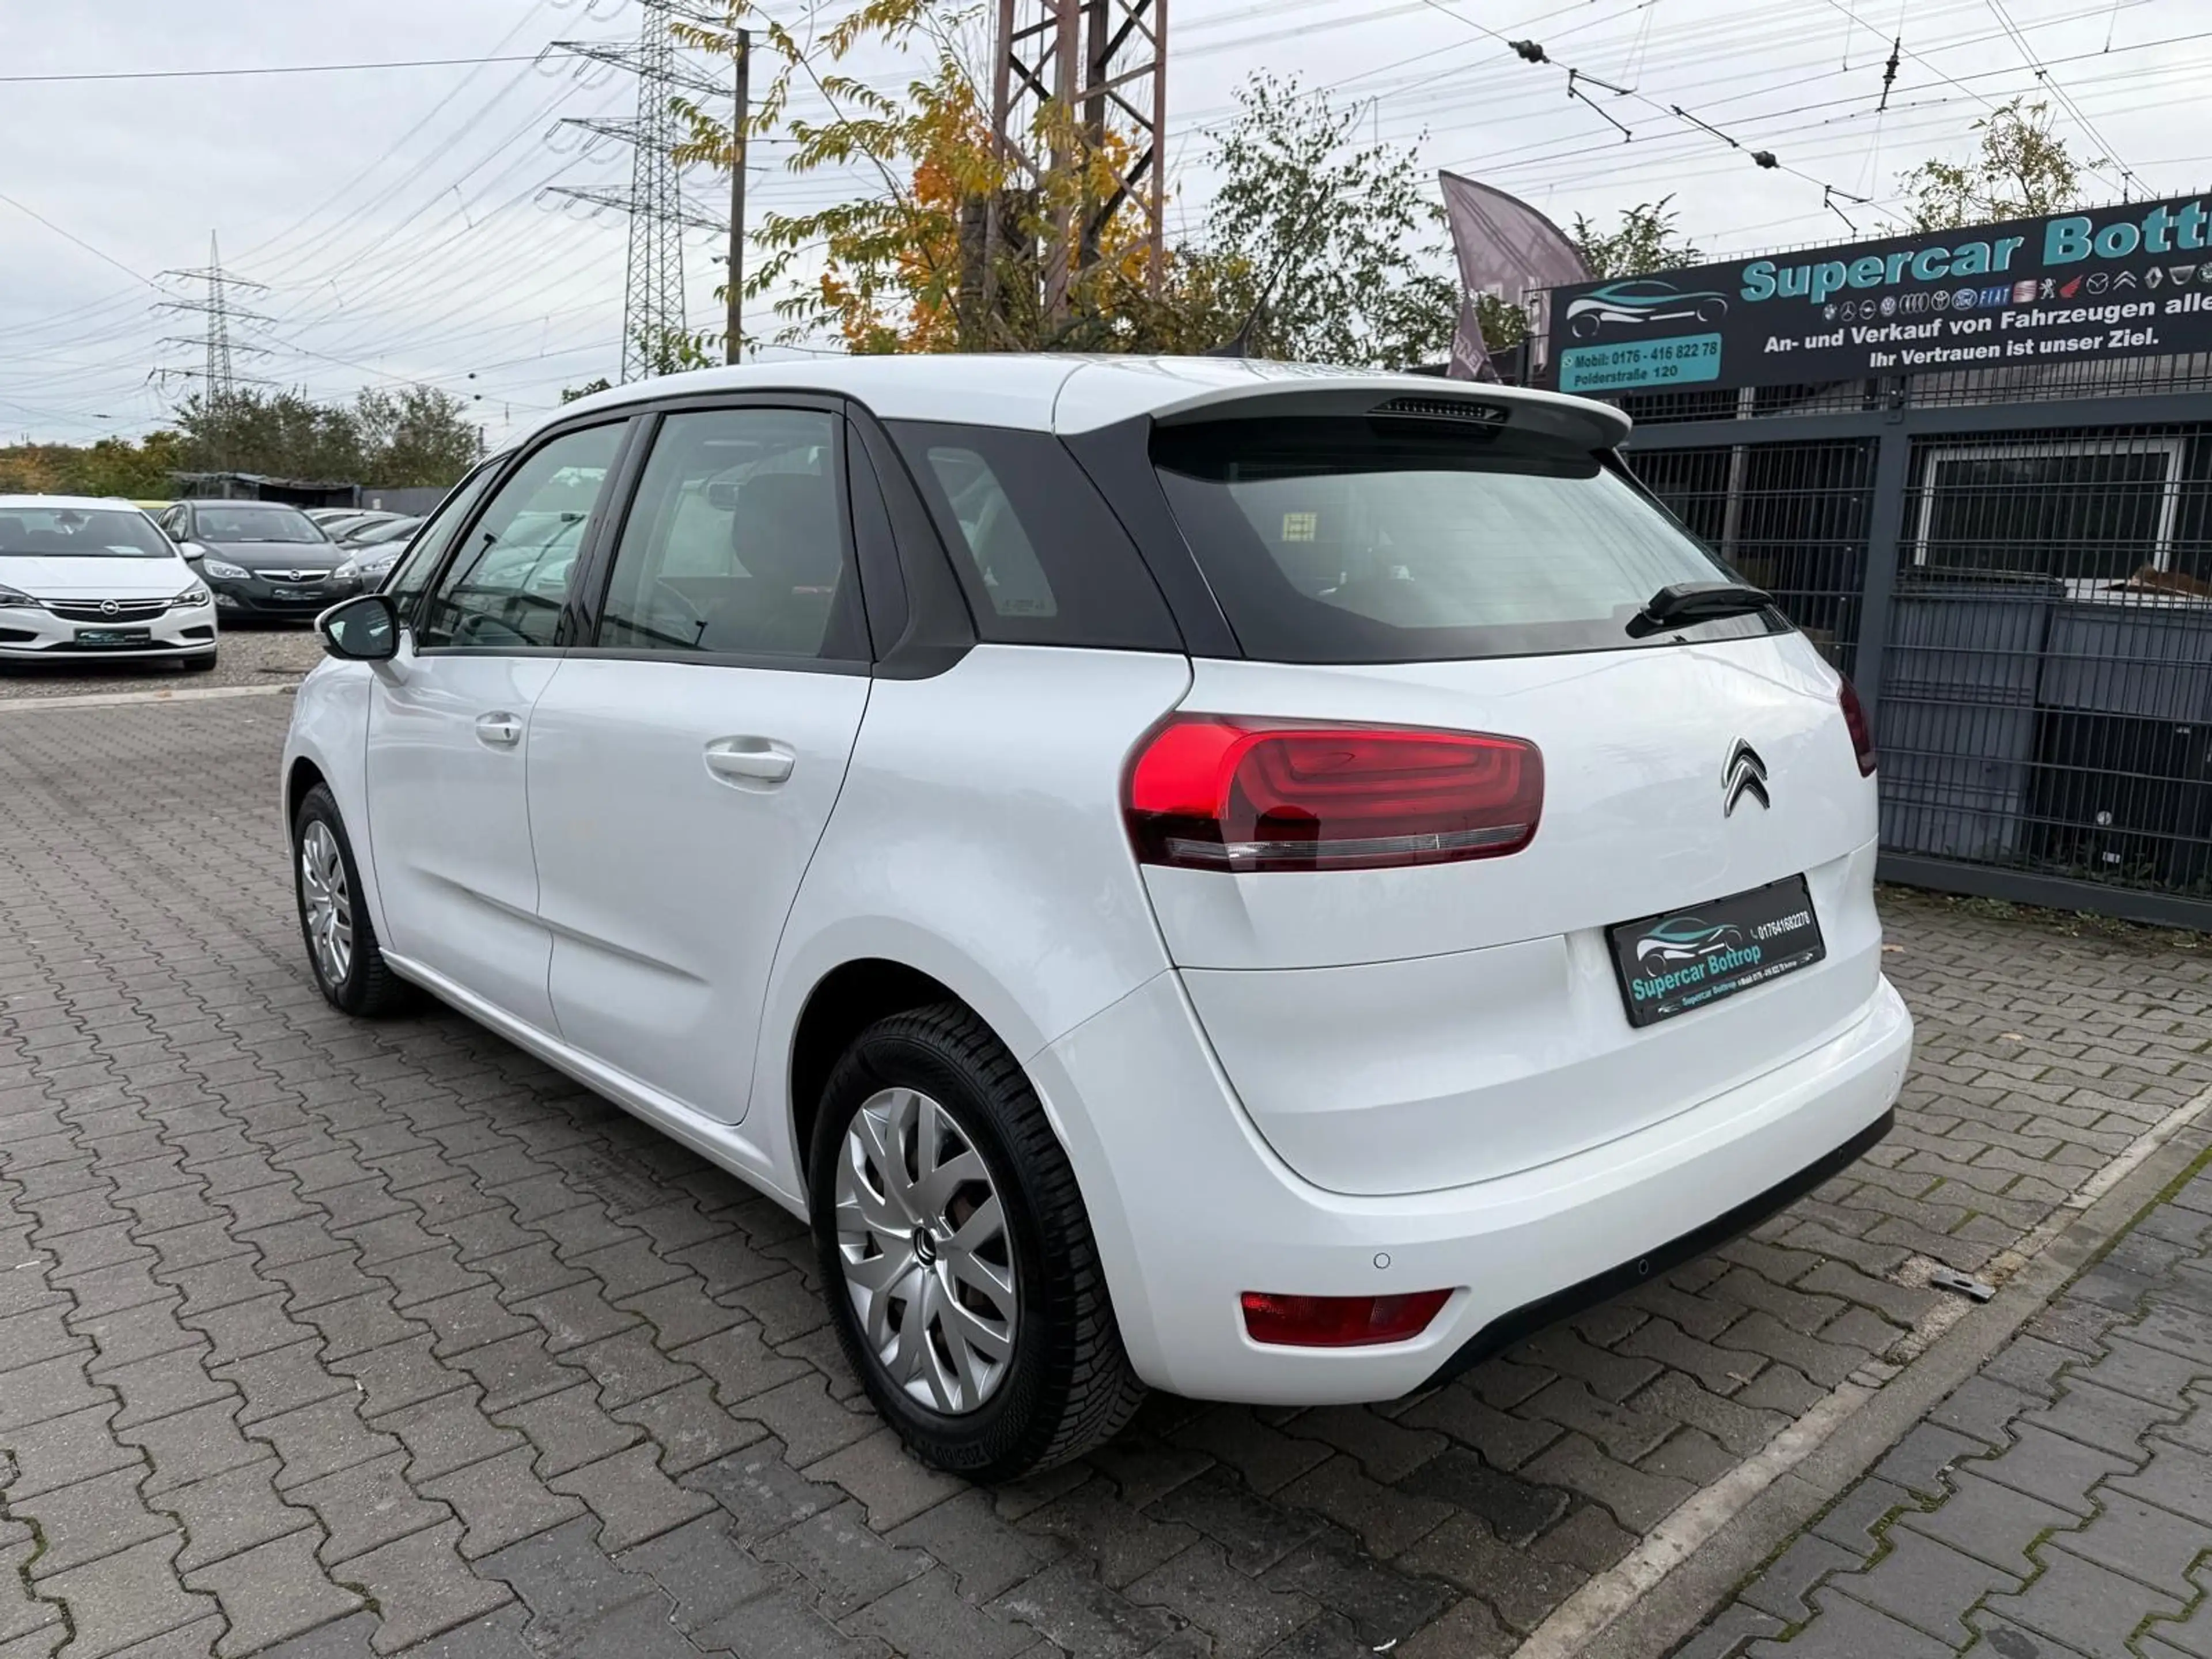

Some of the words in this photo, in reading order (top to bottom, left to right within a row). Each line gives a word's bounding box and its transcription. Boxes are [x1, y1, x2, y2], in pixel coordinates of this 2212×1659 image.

[1740, 236, 2024, 304] Supercar
[2043, 200, 2212, 266] Bott
[1979, 287, 2010, 305] FIAT
[1764, 336, 1800, 353] An-
[1804, 328, 1844, 349] und
[1851, 318, 1943, 344] Verkauf
[1949, 316, 1992, 335] von
[2001, 301, 2156, 329] Fahrzeugen
[1870, 352, 1897, 368] Ihr
[1901, 344, 2001, 365] Vertrauen
[2006, 339, 2035, 357] ist
[2040, 335, 2104, 354] unser
[2108, 327, 2160, 348] Ziel.
[1574, 354, 1609, 369] Mobil:
[1611, 350, 1641, 365] 0176
[1650, 347, 1673, 361] 416
[1676, 343, 1699, 359] 822
[1702, 341, 1718, 355] 78
[1574, 368, 1649, 387] Polderstraße
[1653, 365, 1679, 378] 120
[1632, 963, 1706, 1001] Supercar
[1707, 944, 1762, 976] Bottrop
